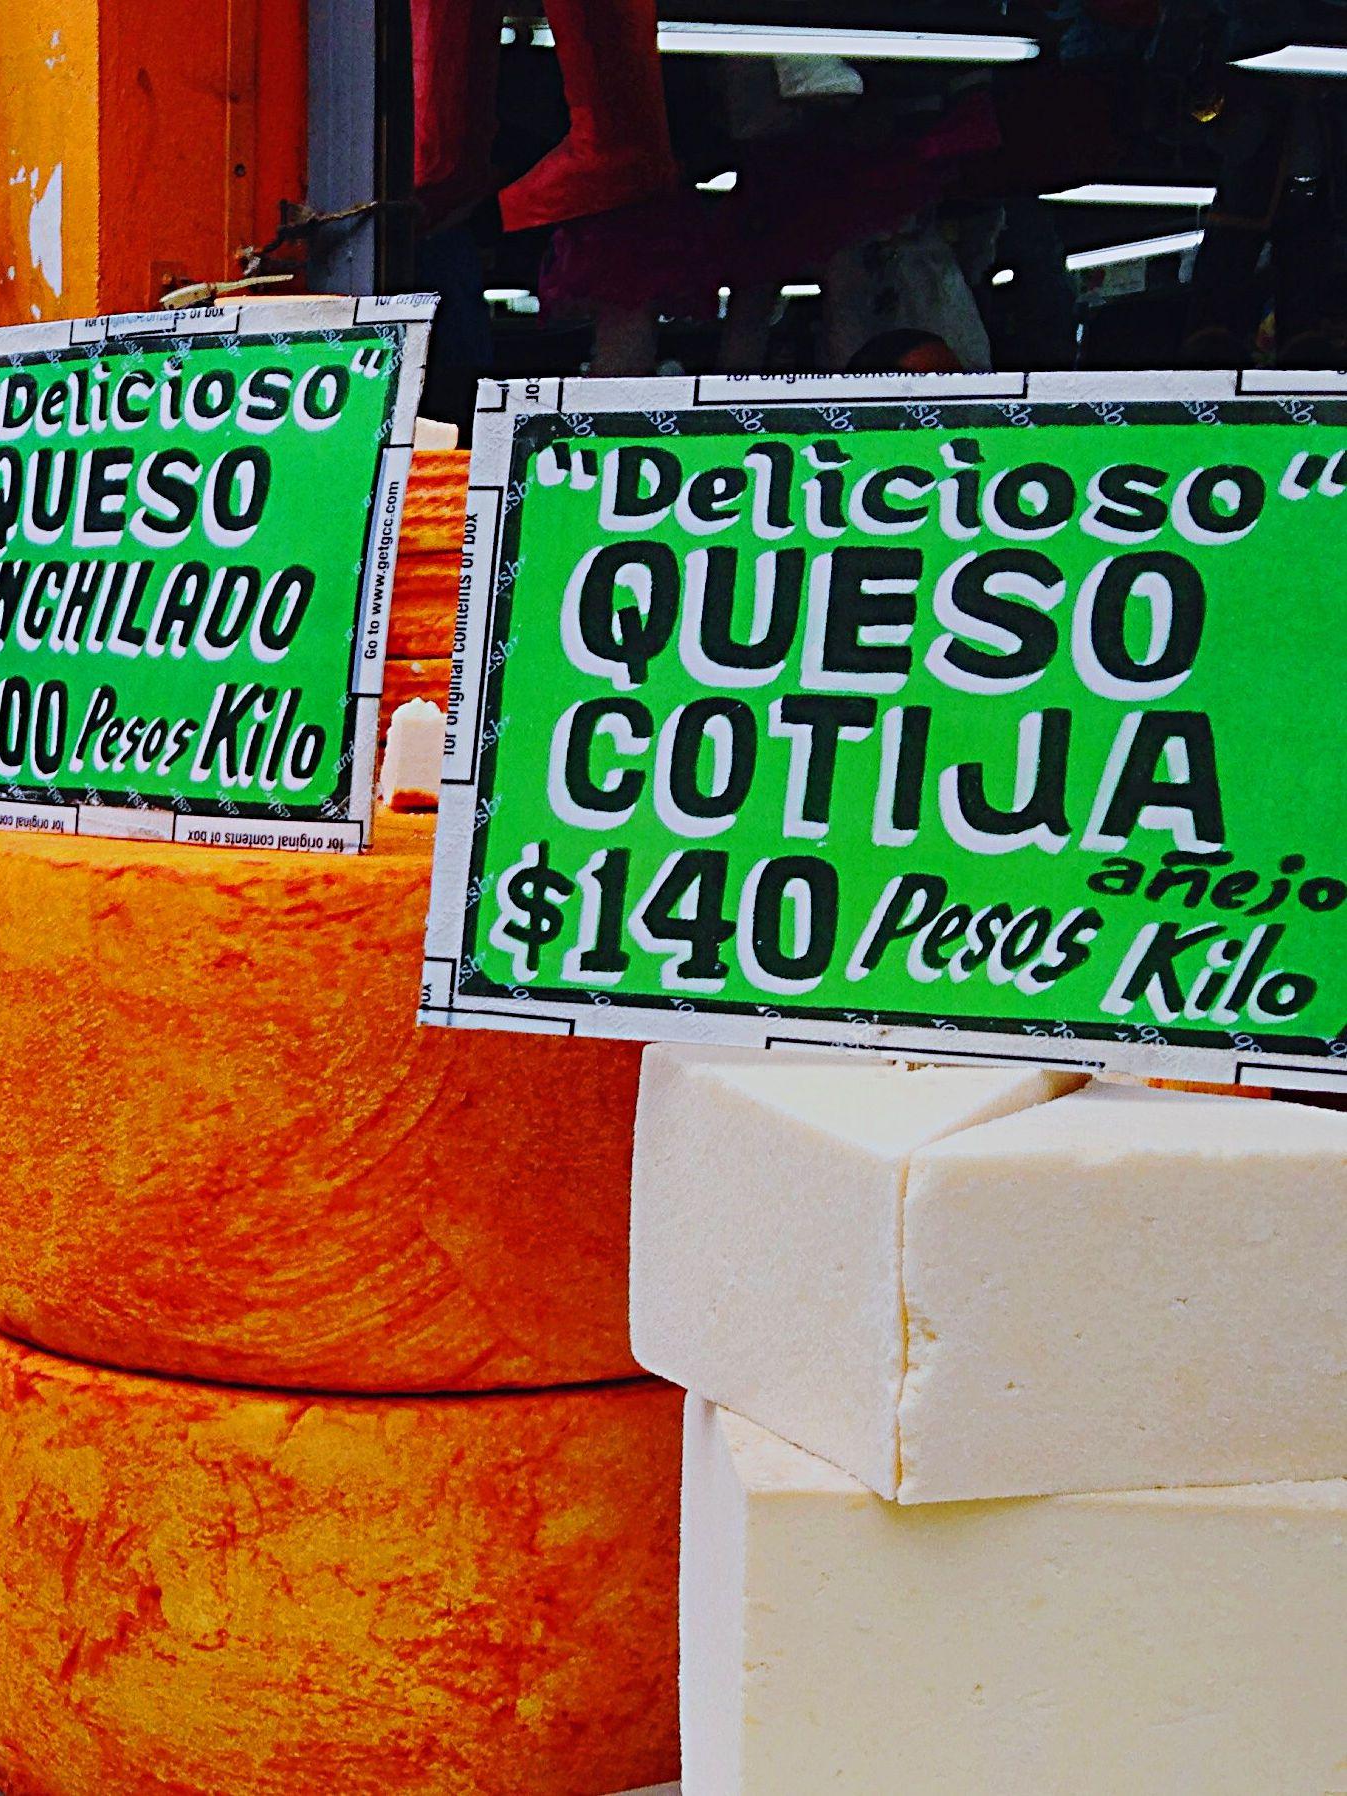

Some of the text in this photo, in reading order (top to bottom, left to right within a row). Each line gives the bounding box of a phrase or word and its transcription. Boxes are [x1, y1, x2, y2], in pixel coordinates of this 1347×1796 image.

[364, 480, 401, 660] Go to www.getgcc.com
[561, 540, 1207, 703] QUESO
[69, 684, 199, 774] Pesos
[189, 682, 327, 791] Kilo
[547, 694, 1226, 856] COTIJA
[15, 815, 49, 831] original
[224, 831, 274, 848] contents
[278, 833, 324, 851] original
[327, 838, 345, 853] for
[1086, 850, 1347, 917] añejo
[490, 838, 1318, 1026] $140 Pesos Kilo
